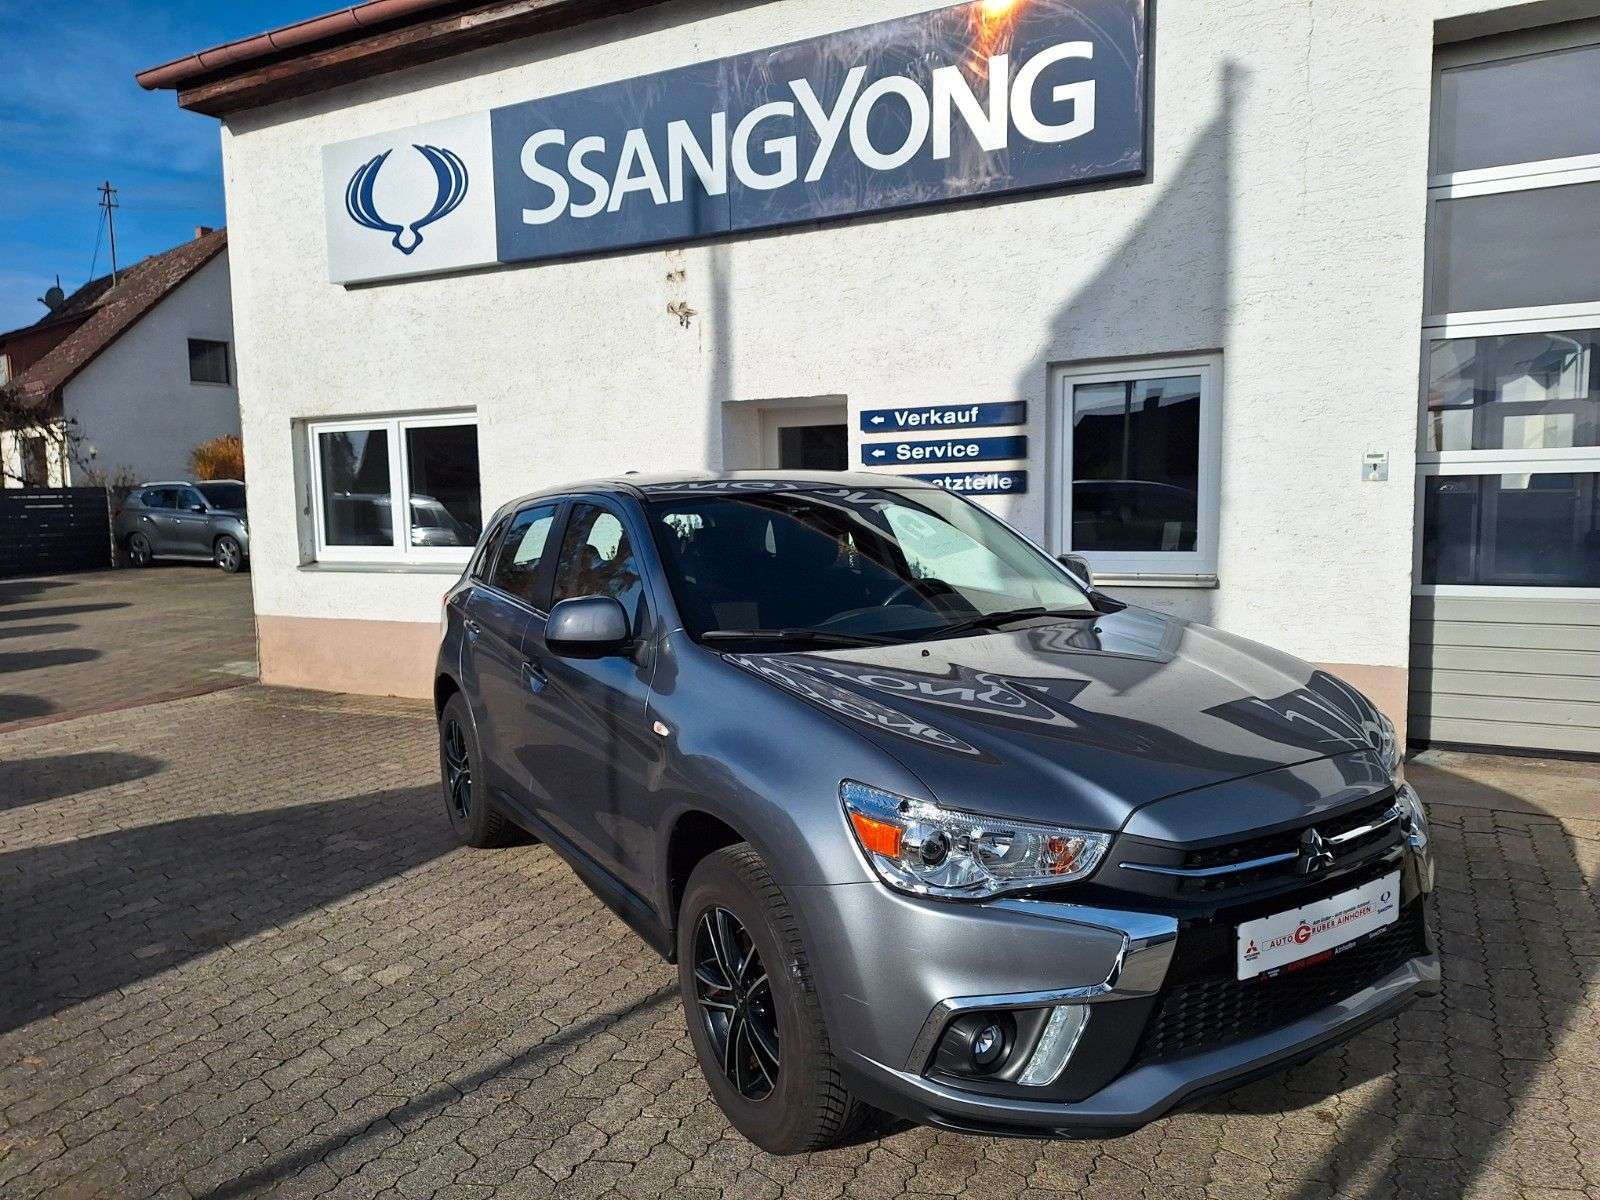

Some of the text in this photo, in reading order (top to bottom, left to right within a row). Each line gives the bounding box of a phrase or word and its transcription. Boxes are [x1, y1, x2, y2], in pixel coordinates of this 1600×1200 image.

[520, 41, 1096, 225] SSANGYONG
[894, 407, 979, 426] Verkauf
[896, 442, 980, 460] Service
[932, 473, 1013, 491] atzteile
[1270, 935, 1293, 948] AUTO
[1337, 906, 1371, 924] AINHOFEN
